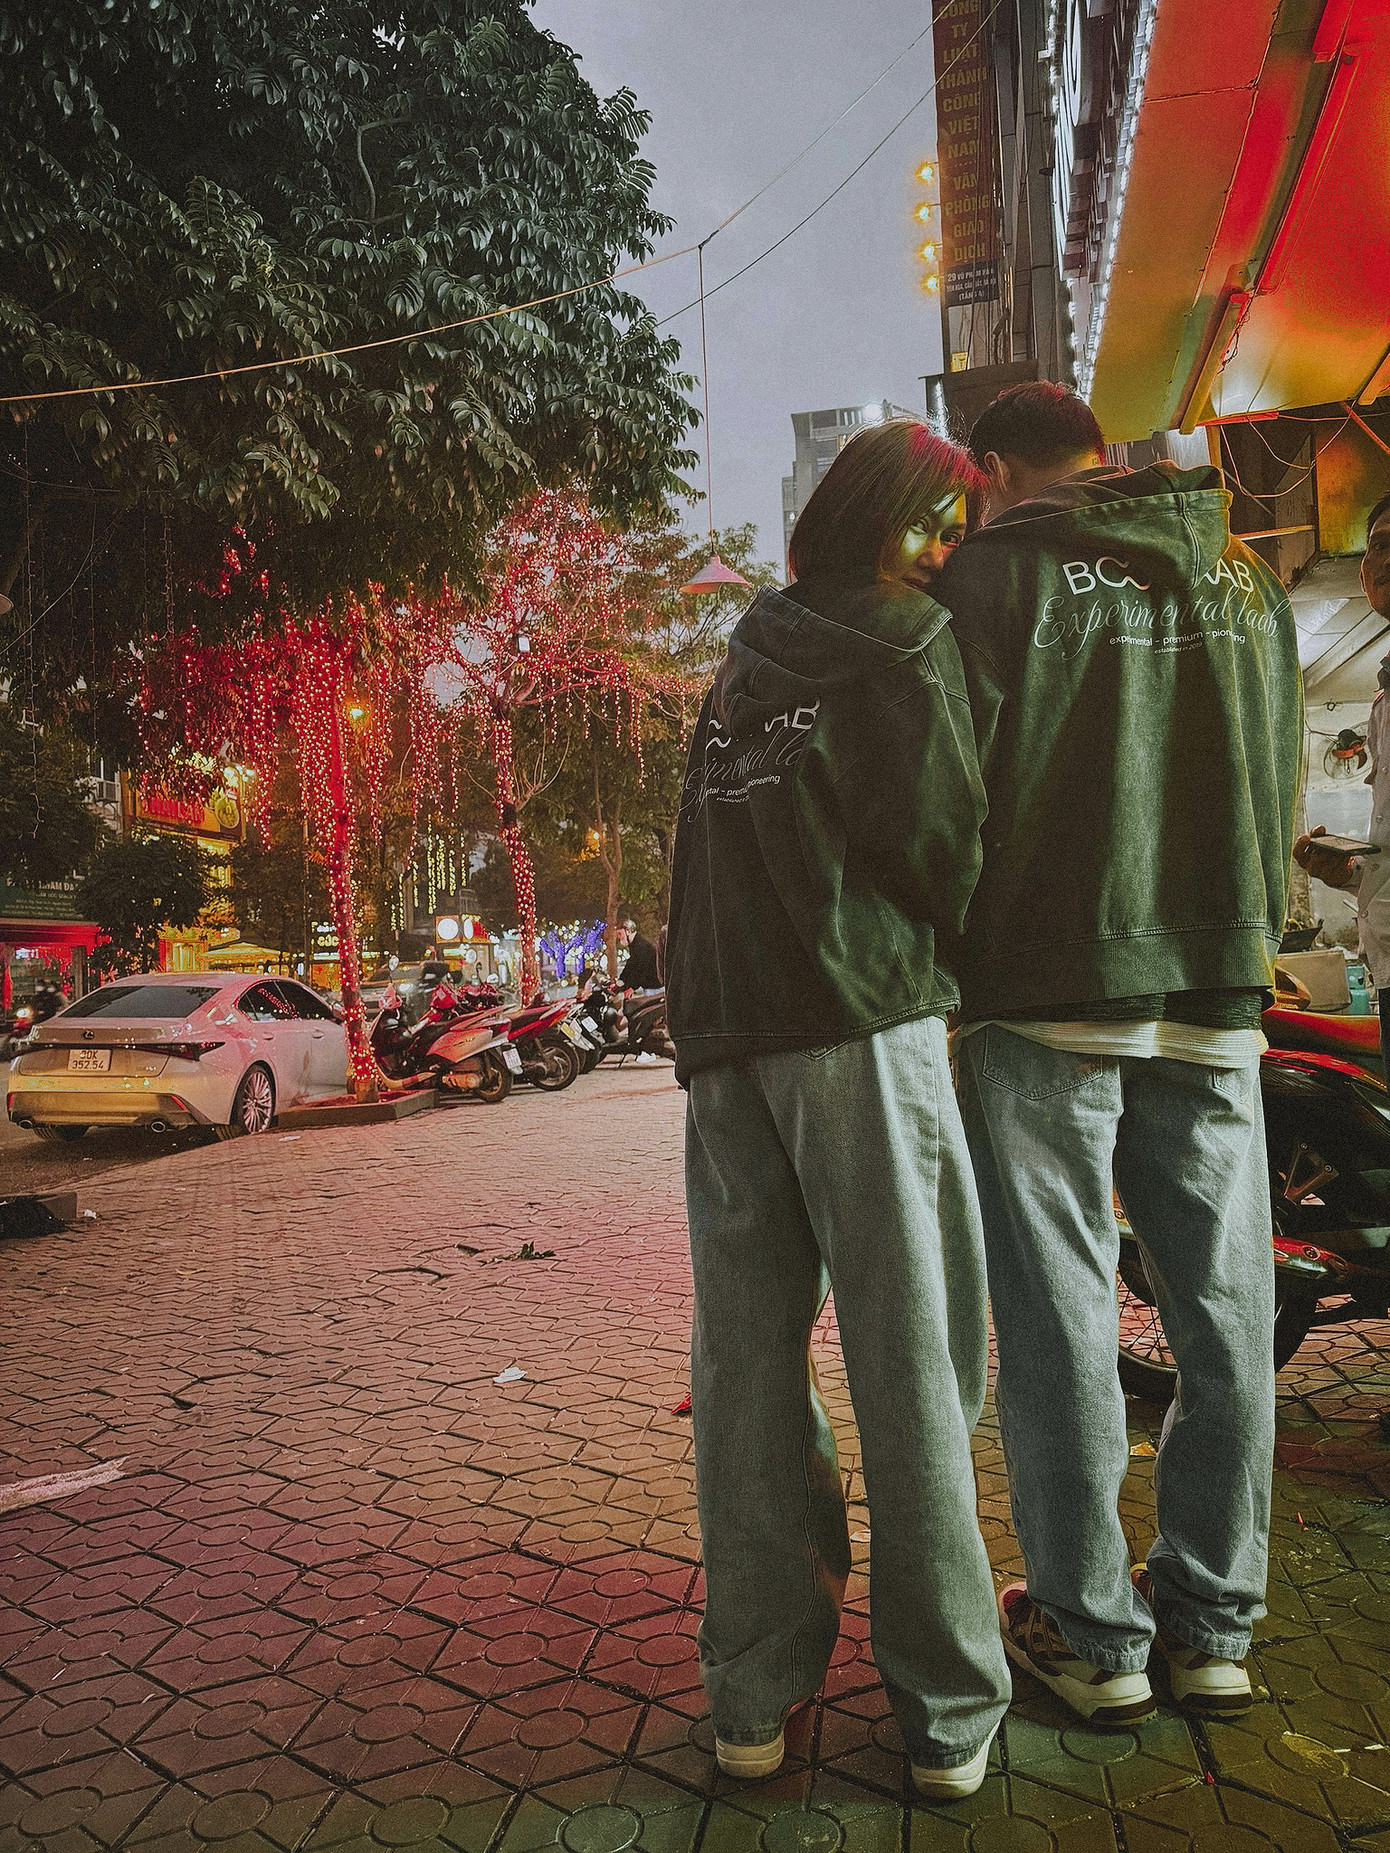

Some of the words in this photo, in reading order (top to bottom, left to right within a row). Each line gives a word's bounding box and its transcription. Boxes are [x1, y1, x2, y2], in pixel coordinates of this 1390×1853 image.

[951, 22, 969, 38] TY
[940, 66, 987, 90] THÀNH
[948, 115, 979, 135] VIỆT
[944, 194, 989, 216] PHÒNG
[947, 272, 957, 282] 29
[1163, 631, 1204, 646] premium
[72, 1060, 104, 1070] 352.54
